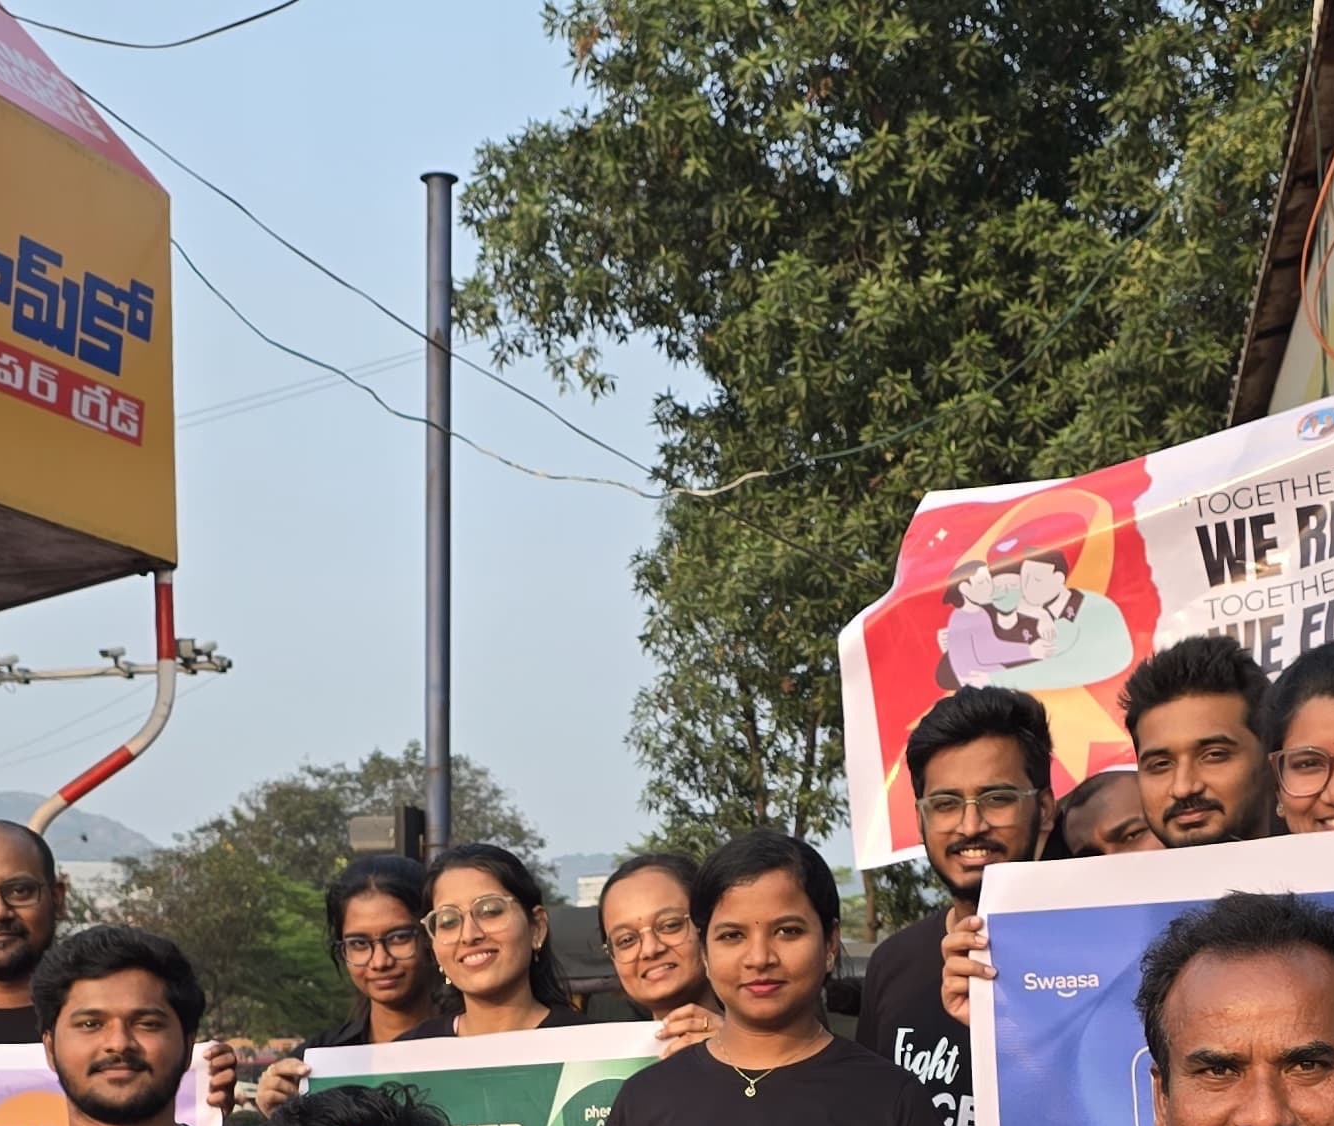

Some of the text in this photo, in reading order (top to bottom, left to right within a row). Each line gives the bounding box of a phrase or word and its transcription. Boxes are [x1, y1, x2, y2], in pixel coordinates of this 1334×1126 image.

[1195, 512, 1283, 588] WE
[1024, 972, 1100, 992] Swaasa
[893, 1027, 960, 1085] Fight
